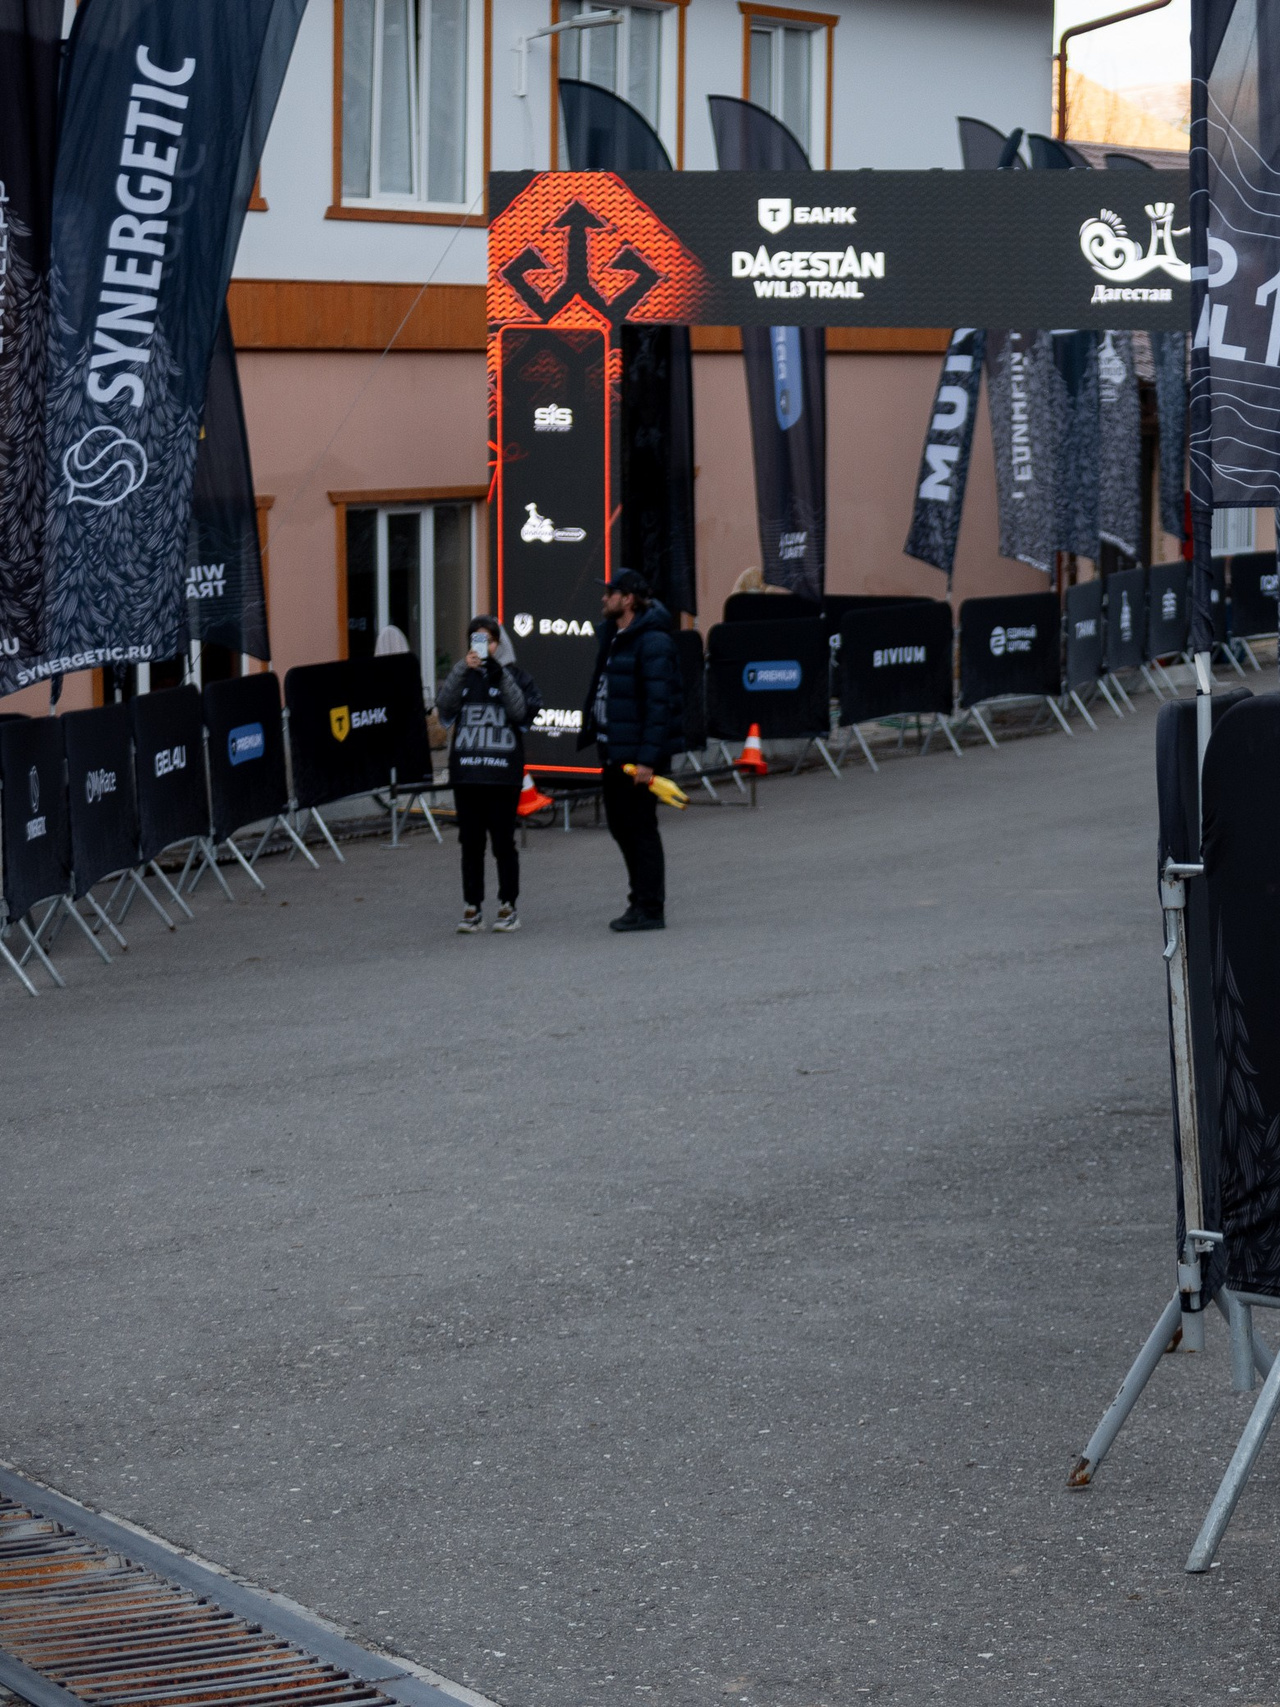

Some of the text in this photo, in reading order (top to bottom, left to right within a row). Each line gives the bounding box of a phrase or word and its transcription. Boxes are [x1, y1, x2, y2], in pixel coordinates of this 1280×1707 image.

[86, 44, 196, 408] SYNERGETIC
[793, 206, 858, 225] БАНК
[753, 280, 865, 300] WILD TRAIL
[1090, 284, 1173, 304] Дагестан
[16, 644, 153, 686] SYNERGETIC.RU
[873, 646, 927, 668] BIVIUM
[351, 706, 388, 729] БАНК
[155, 744, 187, 777] GEL4U
